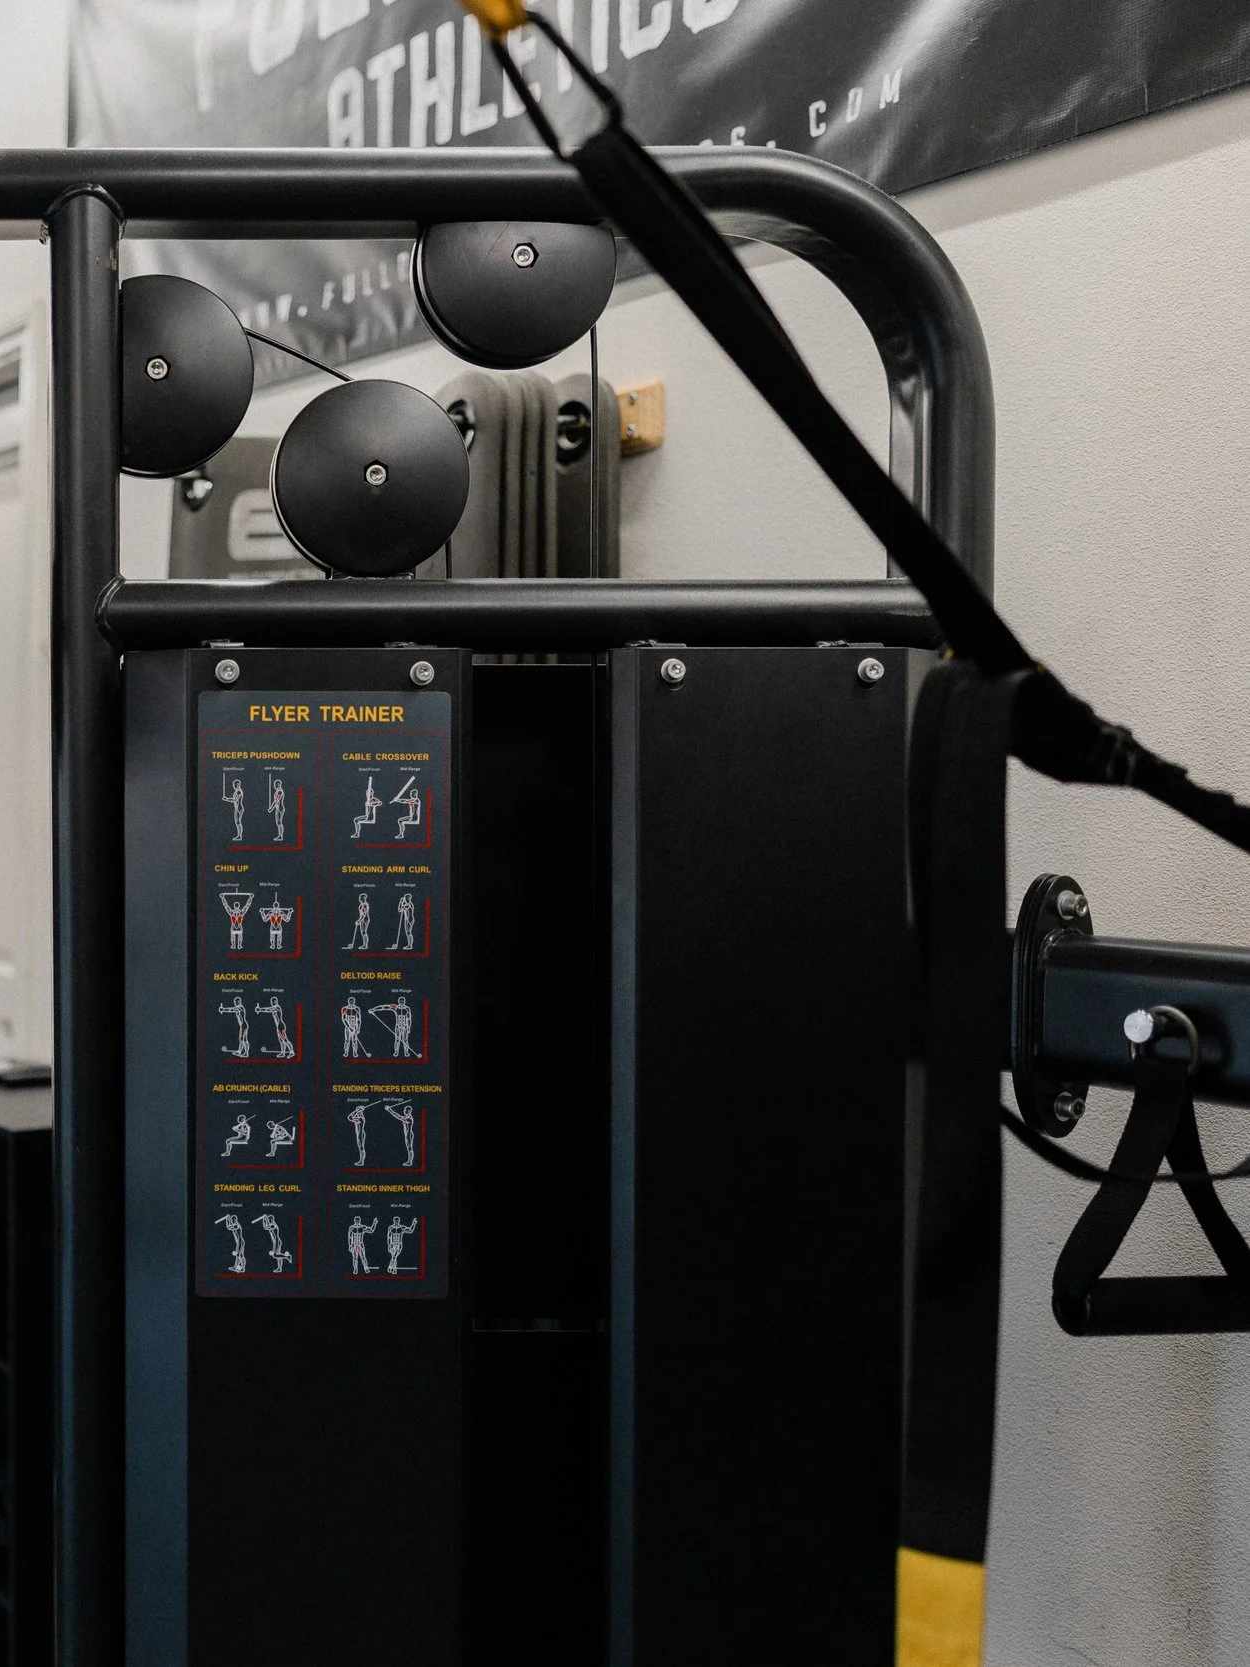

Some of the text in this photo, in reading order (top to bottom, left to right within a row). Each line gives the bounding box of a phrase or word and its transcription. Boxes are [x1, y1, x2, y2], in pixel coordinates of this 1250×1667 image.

[249, 705, 405, 723] FLYER TRAINER
[212, 751, 301, 760] TRICEPS PUSHDOWN
[342, 753, 430, 761] CABLE CROSSOVER
[214, 864, 249, 872] CHIN UP
[341, 865, 431, 873] STANDING ARM CURL
[213, 973, 259, 981] BACK KICK
[340, 972, 402, 980] DELTOID RAISE
[212, 1084, 291, 1093] AB CRUNCH (CABLE)
[332, 1084, 442, 1093] STANDING TRICEPS EXTENSION
[213, 1184, 301, 1192] STANDING LEG CURL
[336, 1184, 431, 1192] STANDING INNER THIGH
